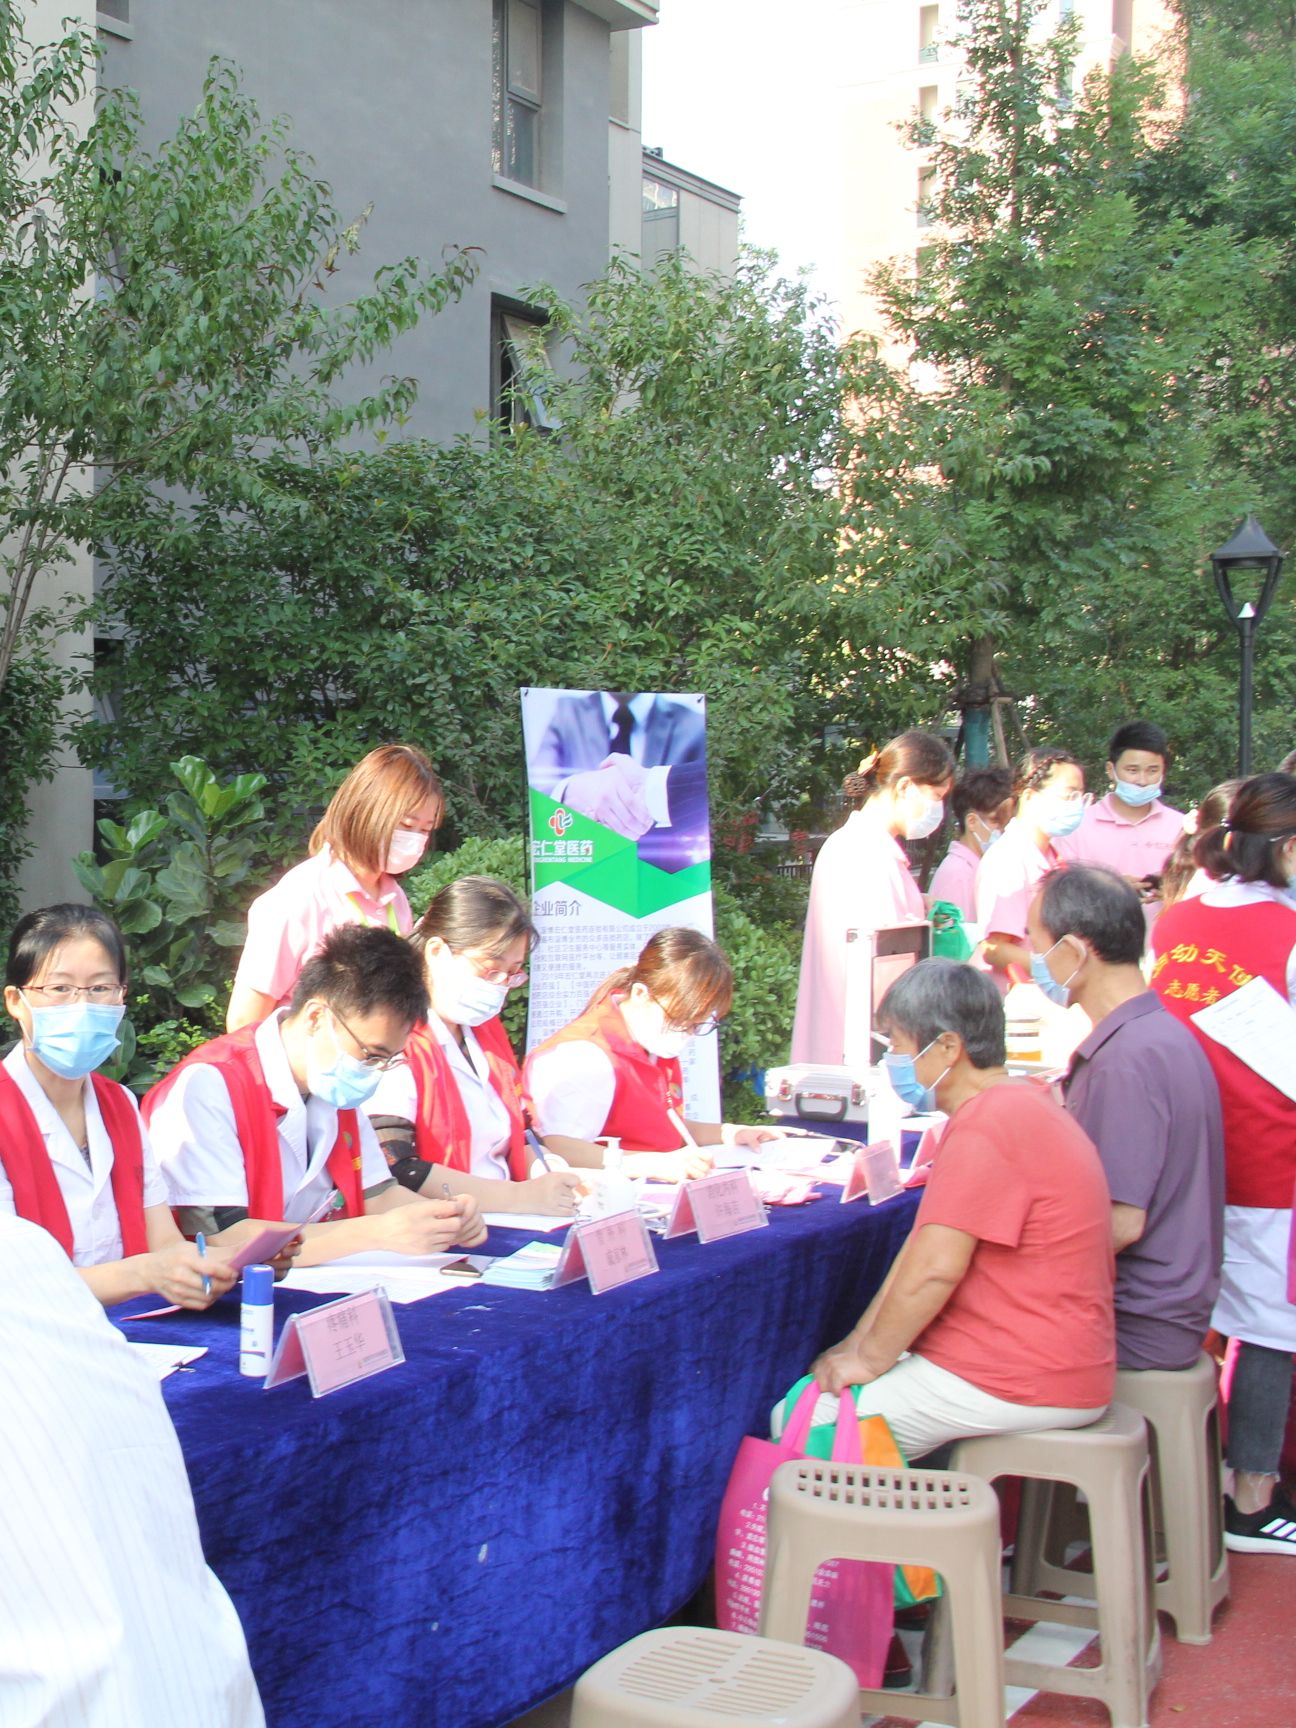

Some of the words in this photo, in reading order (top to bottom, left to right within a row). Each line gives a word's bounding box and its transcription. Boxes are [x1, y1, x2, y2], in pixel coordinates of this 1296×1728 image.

[532, 840, 594, 856] 宏仁堂医药
[533, 900, 581, 916] 企业简介
[1163, 979, 1221, 1005] 志愿者
